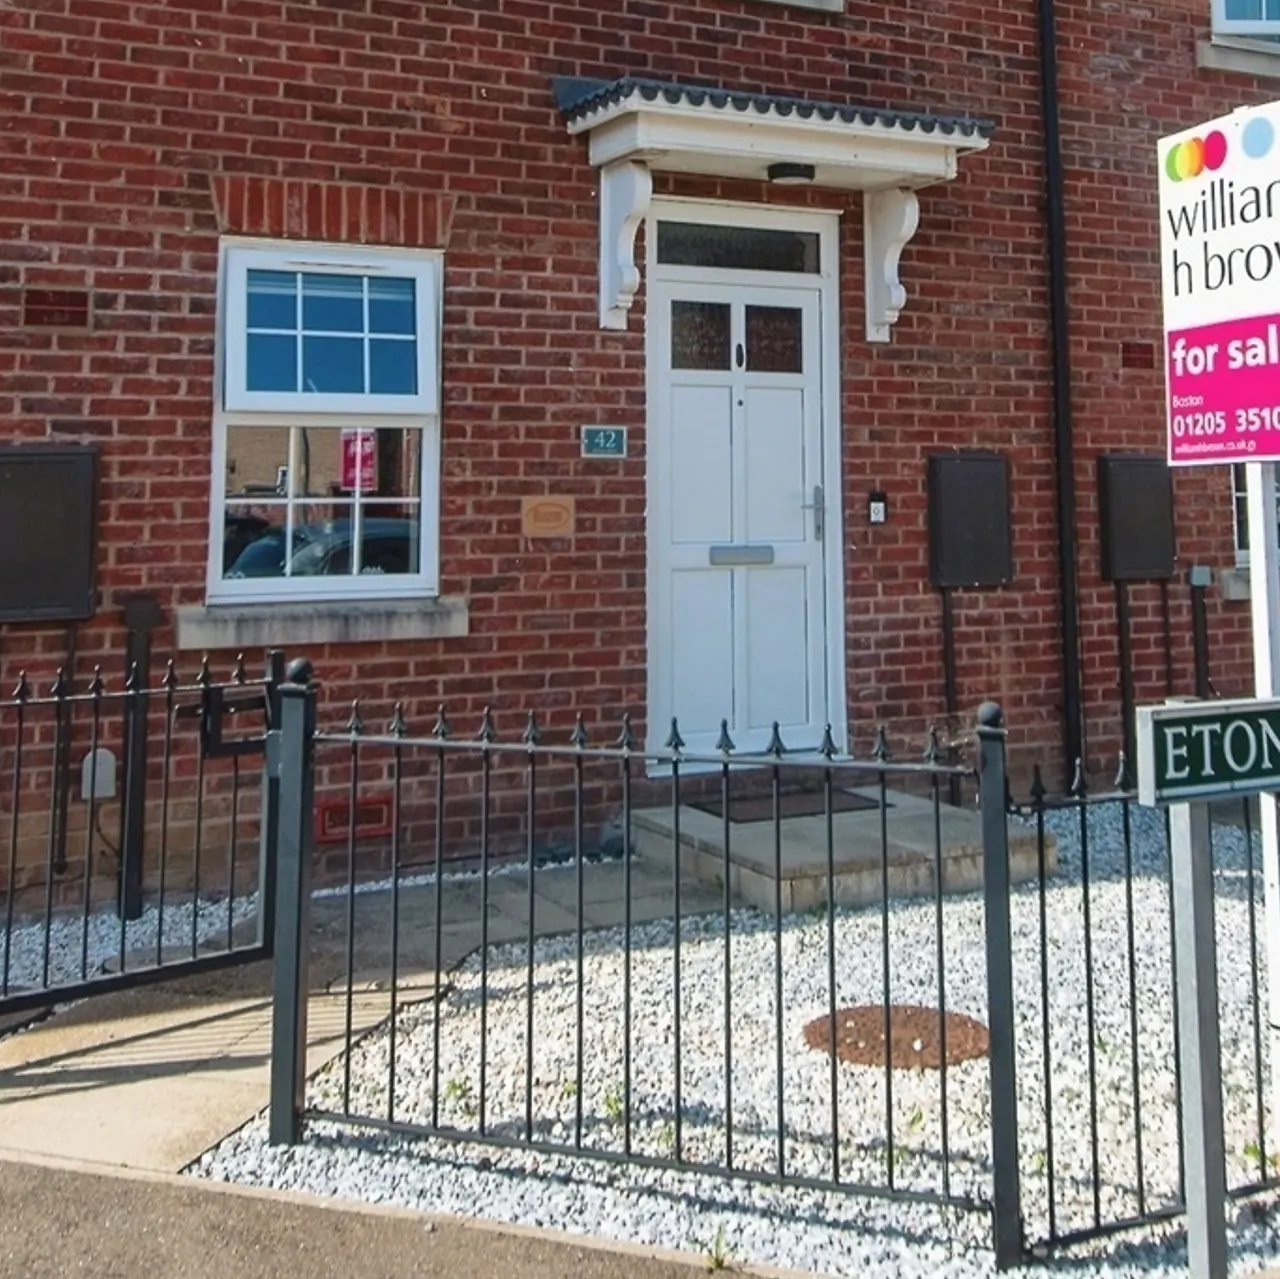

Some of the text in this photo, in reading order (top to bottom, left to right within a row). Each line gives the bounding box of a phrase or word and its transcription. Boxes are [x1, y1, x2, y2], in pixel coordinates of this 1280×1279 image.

[1173, 248, 1193, 297] h
[1172, 337, 1219, 377] for
[1172, 394, 1204, 408] Boston
[1173, 411, 1226, 437] 01205
[595, 431, 616, 448] 42
